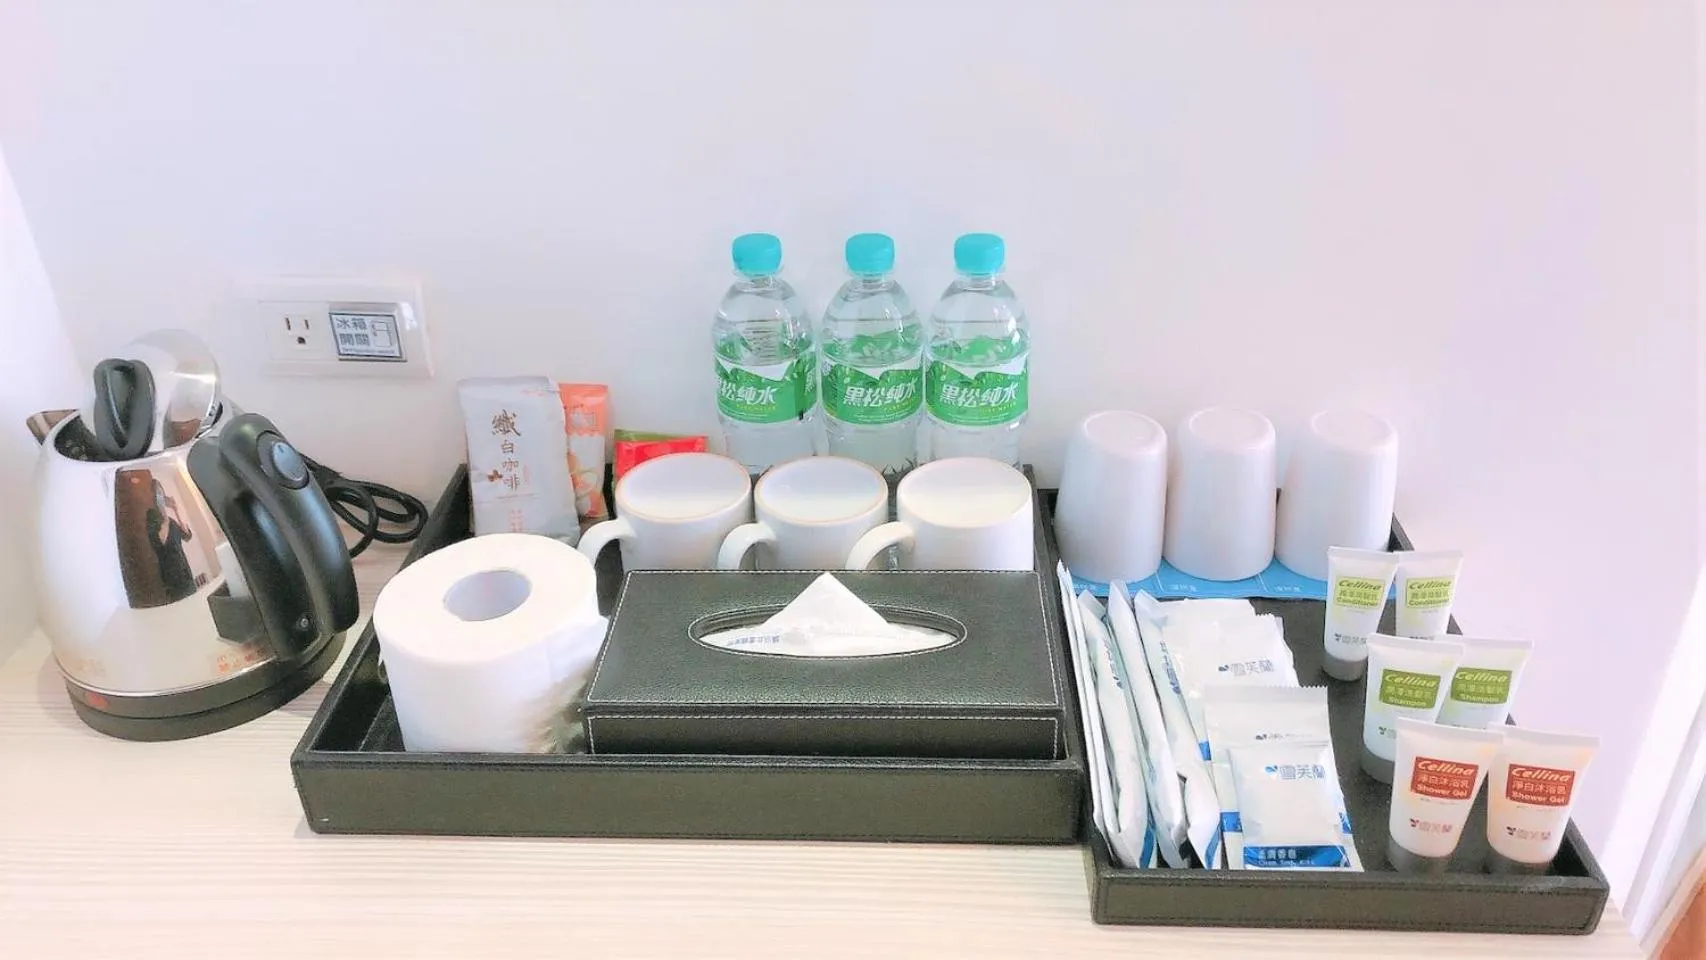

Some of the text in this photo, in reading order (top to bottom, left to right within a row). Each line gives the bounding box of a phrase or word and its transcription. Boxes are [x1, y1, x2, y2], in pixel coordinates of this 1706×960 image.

[335, 317, 368, 330] 冰箱
[1418, 761, 1474, 776] Cellina
[1512, 768, 1571, 782] Cellina
[1417, 784, 1468, 797] Shower Gel
[1511, 791, 1547, 801] Shower
